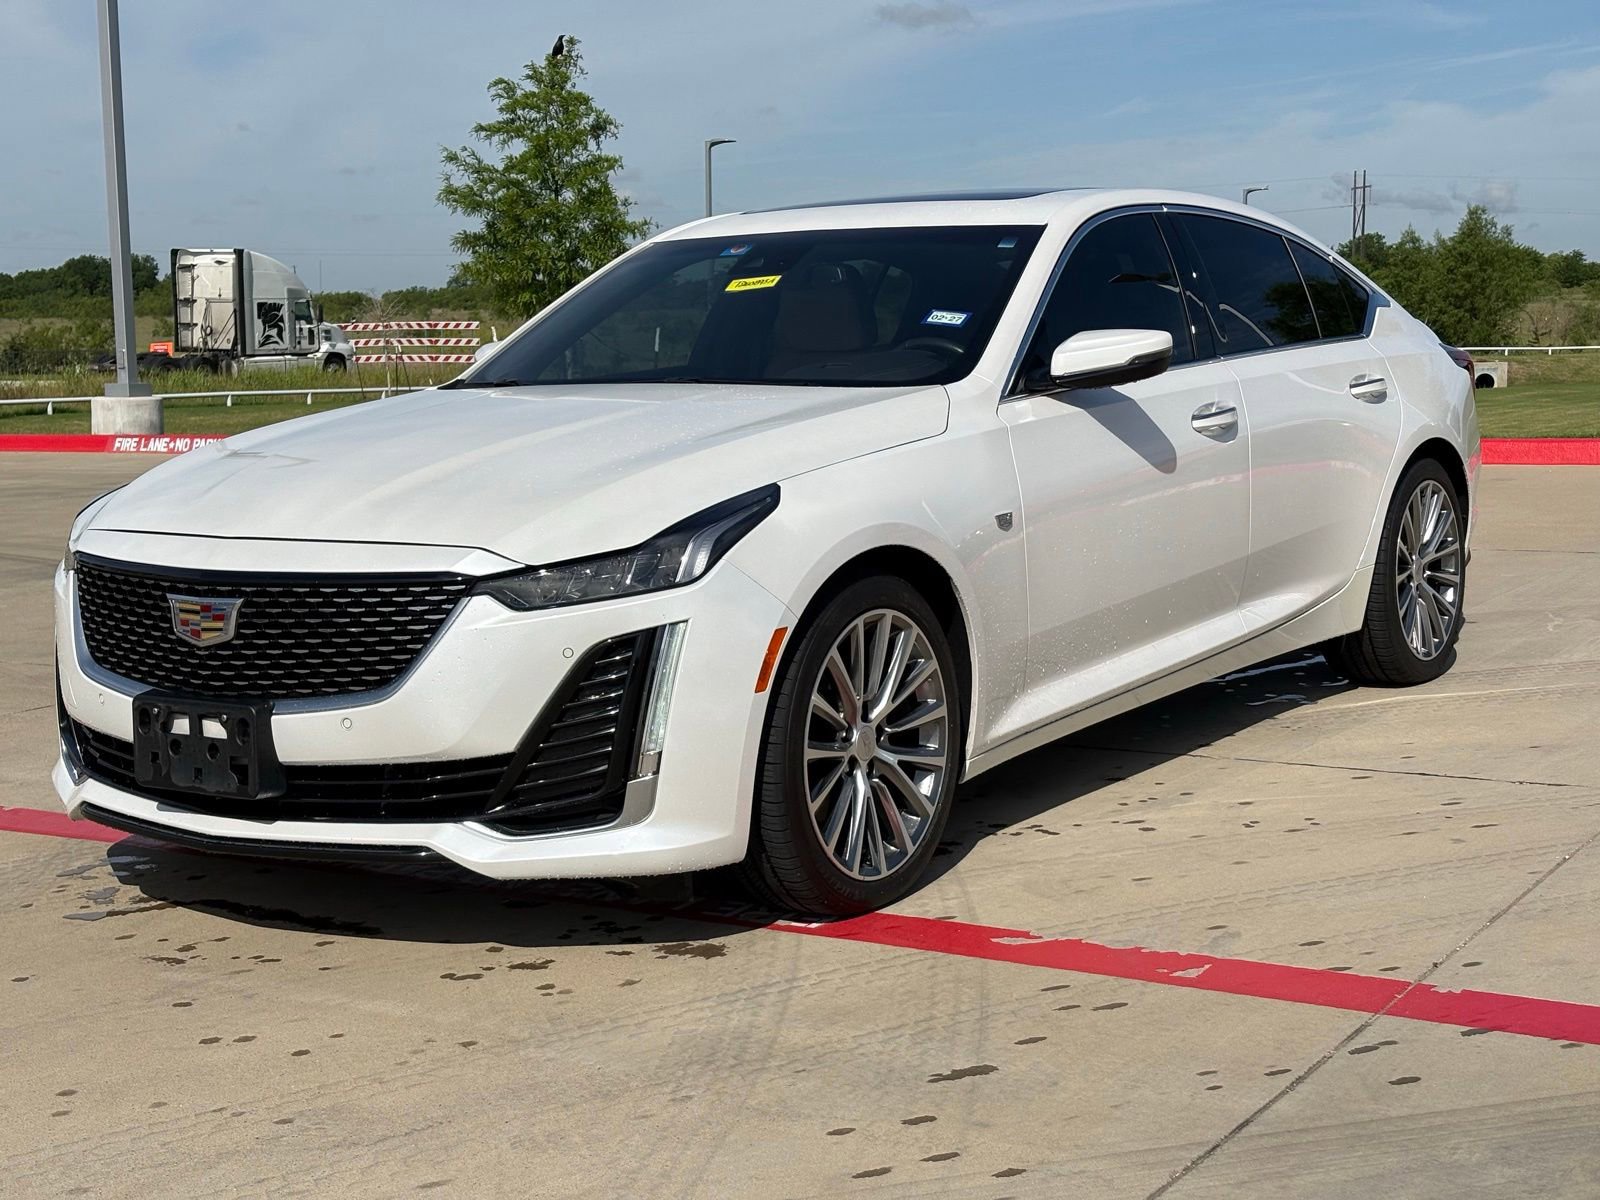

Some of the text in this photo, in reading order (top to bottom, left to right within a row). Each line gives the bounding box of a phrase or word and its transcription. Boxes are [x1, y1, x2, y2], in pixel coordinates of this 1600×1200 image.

[113, 437, 139, 452] FIRE
[140, 437, 171, 452] LANE
[174, 437, 190, 452] NO
